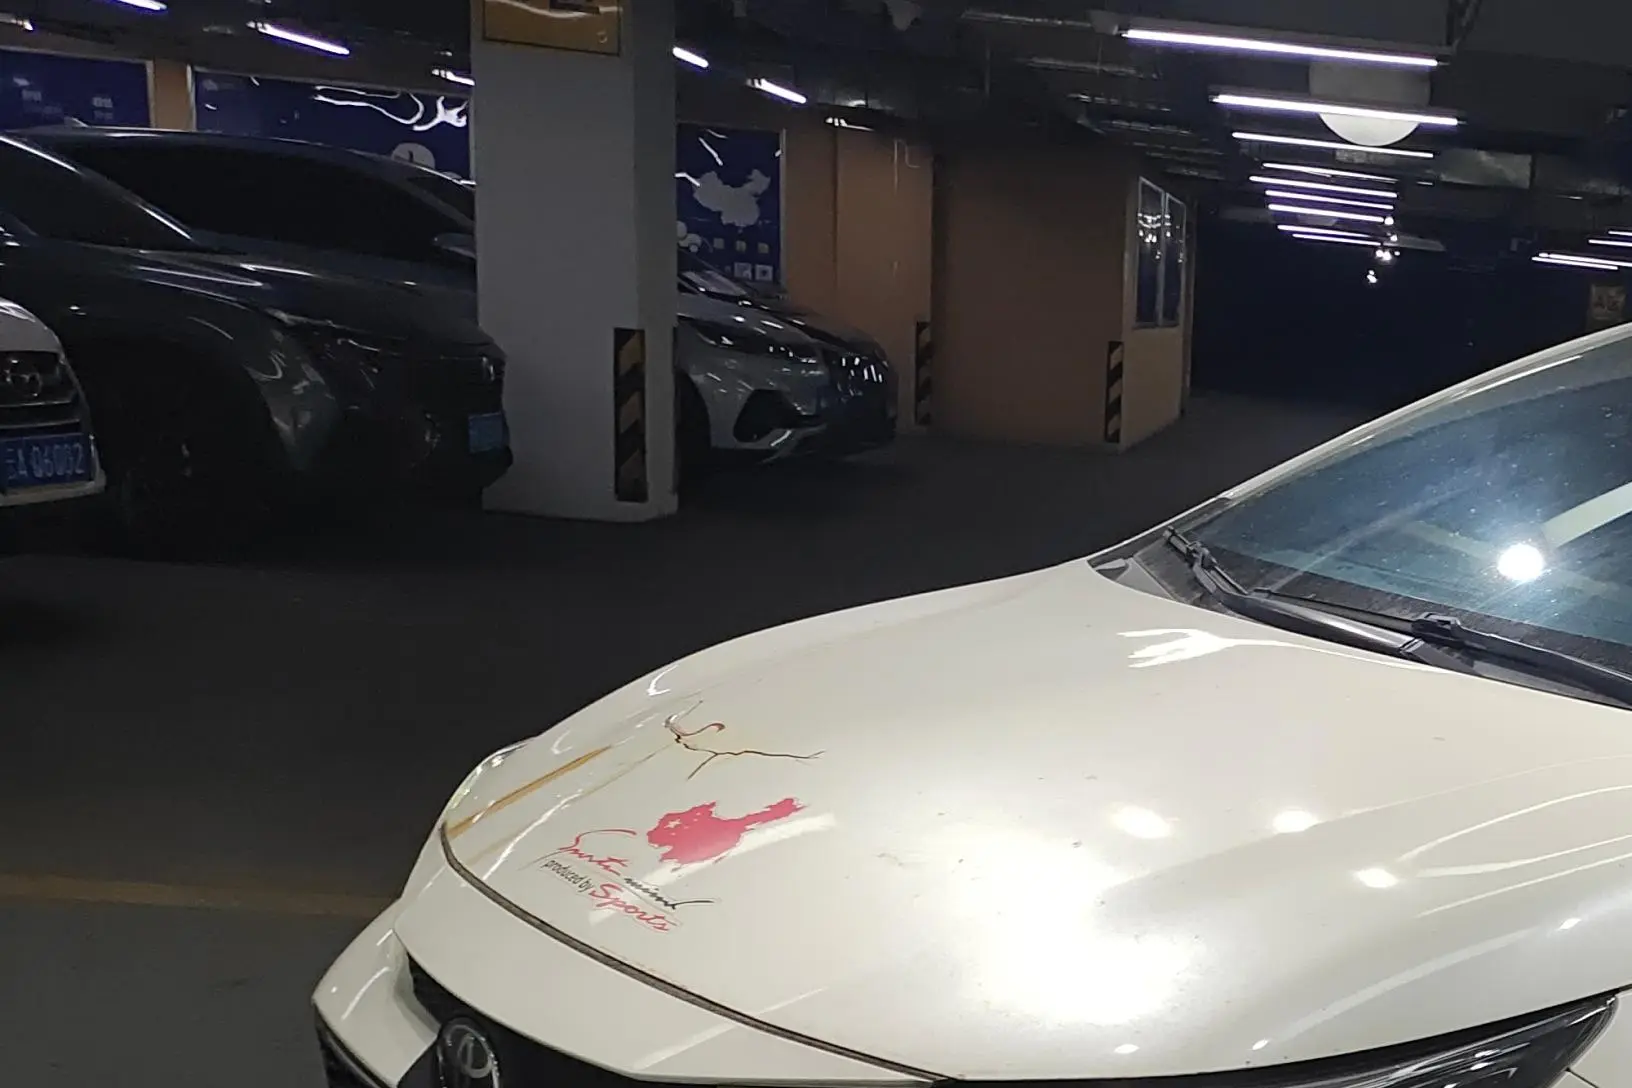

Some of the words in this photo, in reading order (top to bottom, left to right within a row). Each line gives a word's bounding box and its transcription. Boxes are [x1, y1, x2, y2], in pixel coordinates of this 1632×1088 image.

[540, 859, 589, 886] produced
[577, 877, 595, 893] by
[588, 883, 678, 932] Sports
